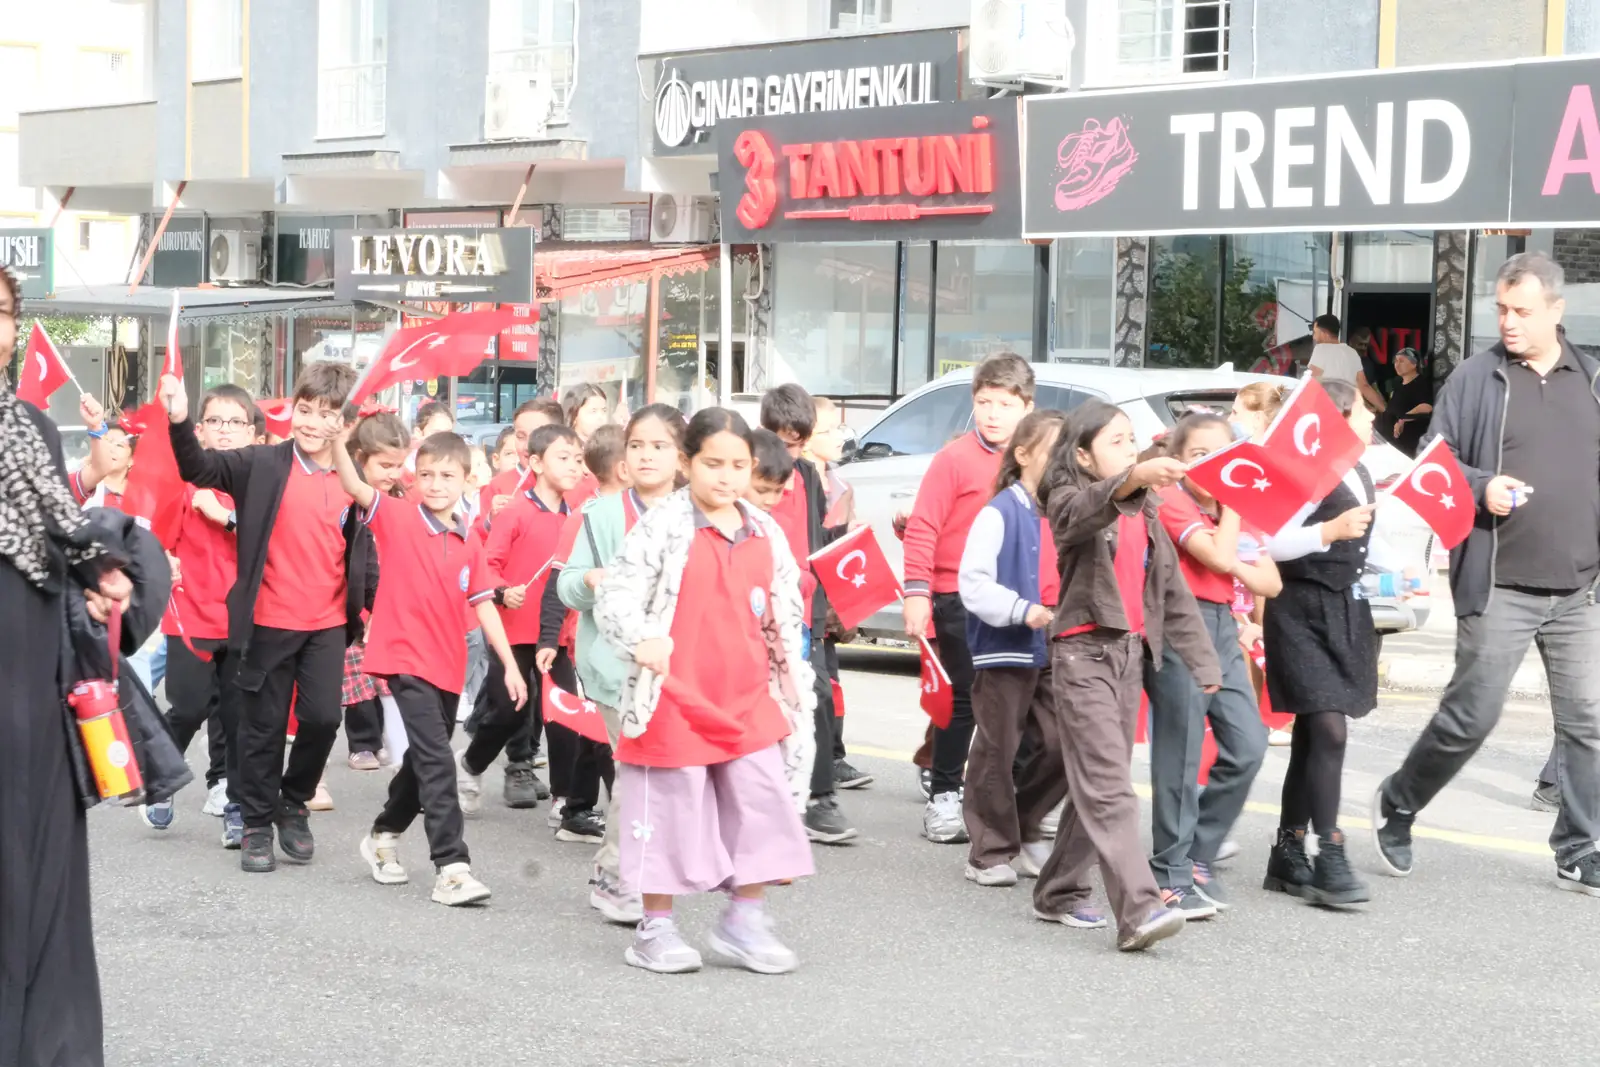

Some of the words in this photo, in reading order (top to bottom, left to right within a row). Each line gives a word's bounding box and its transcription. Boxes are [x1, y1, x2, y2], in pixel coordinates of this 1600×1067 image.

[690, 77, 757, 143] ÇINAR
[764, 62, 940, 116] GAYRİMENKUL
[782, 115, 994, 199] TANTUNİ
[1170, 99, 1470, 210] TREND
[299, 228, 331, 249] KAHVE
[351, 233, 499, 276] LEVORA
